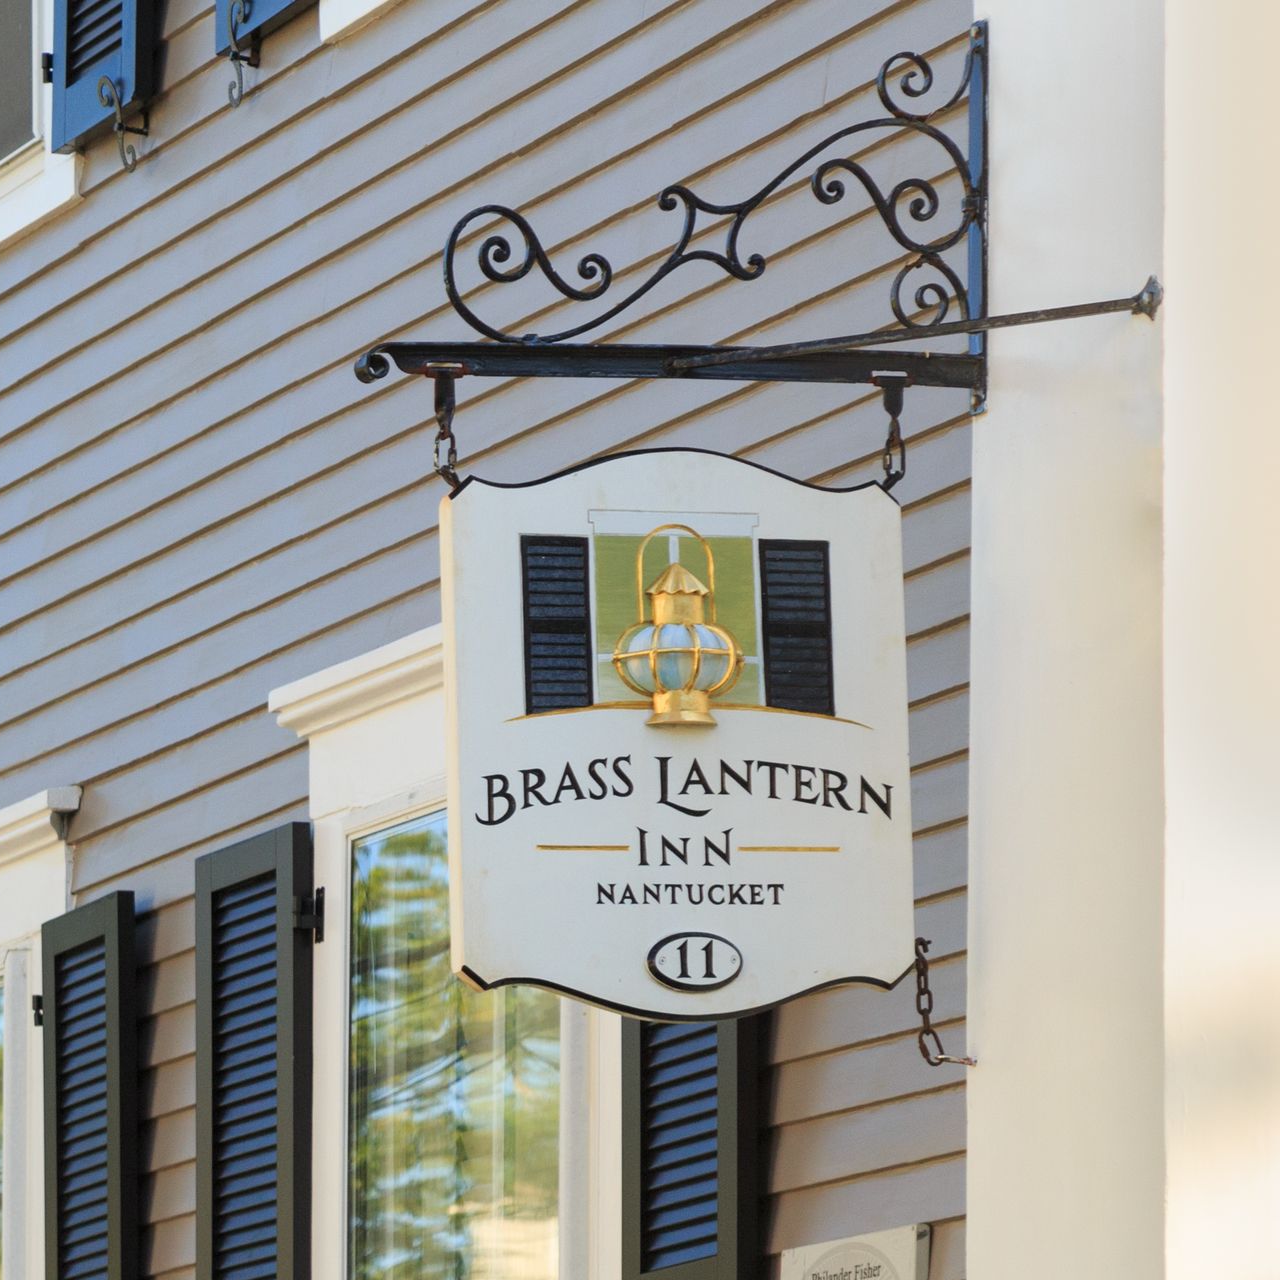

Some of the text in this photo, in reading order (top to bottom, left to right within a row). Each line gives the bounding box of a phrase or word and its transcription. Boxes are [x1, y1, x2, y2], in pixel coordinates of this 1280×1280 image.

[475, 754, 895, 826] BRASS LANTERN
[636, 826, 734, 866] INN
[596, 882, 785, 906] NANTUCKET
[676, 938, 718, 979] 11
[854, 1262, 882, 1280] Fisher
